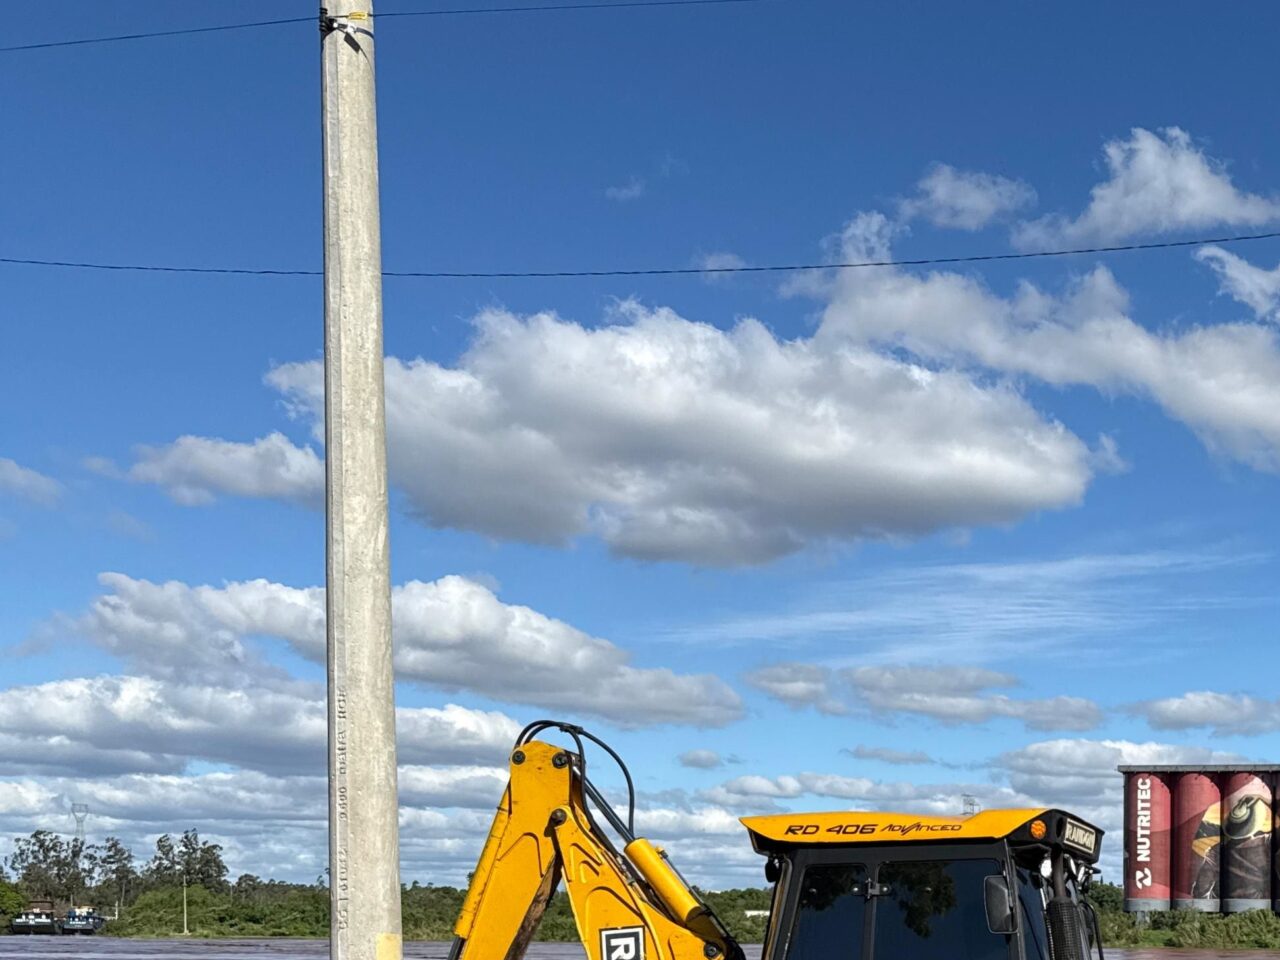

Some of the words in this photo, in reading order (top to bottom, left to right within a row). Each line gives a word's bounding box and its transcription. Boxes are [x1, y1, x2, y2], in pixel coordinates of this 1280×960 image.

[784, 824, 820, 836] RD
[826, 823, 879, 836] 406
[1136, 777, 1152, 862] NUTRITEC
